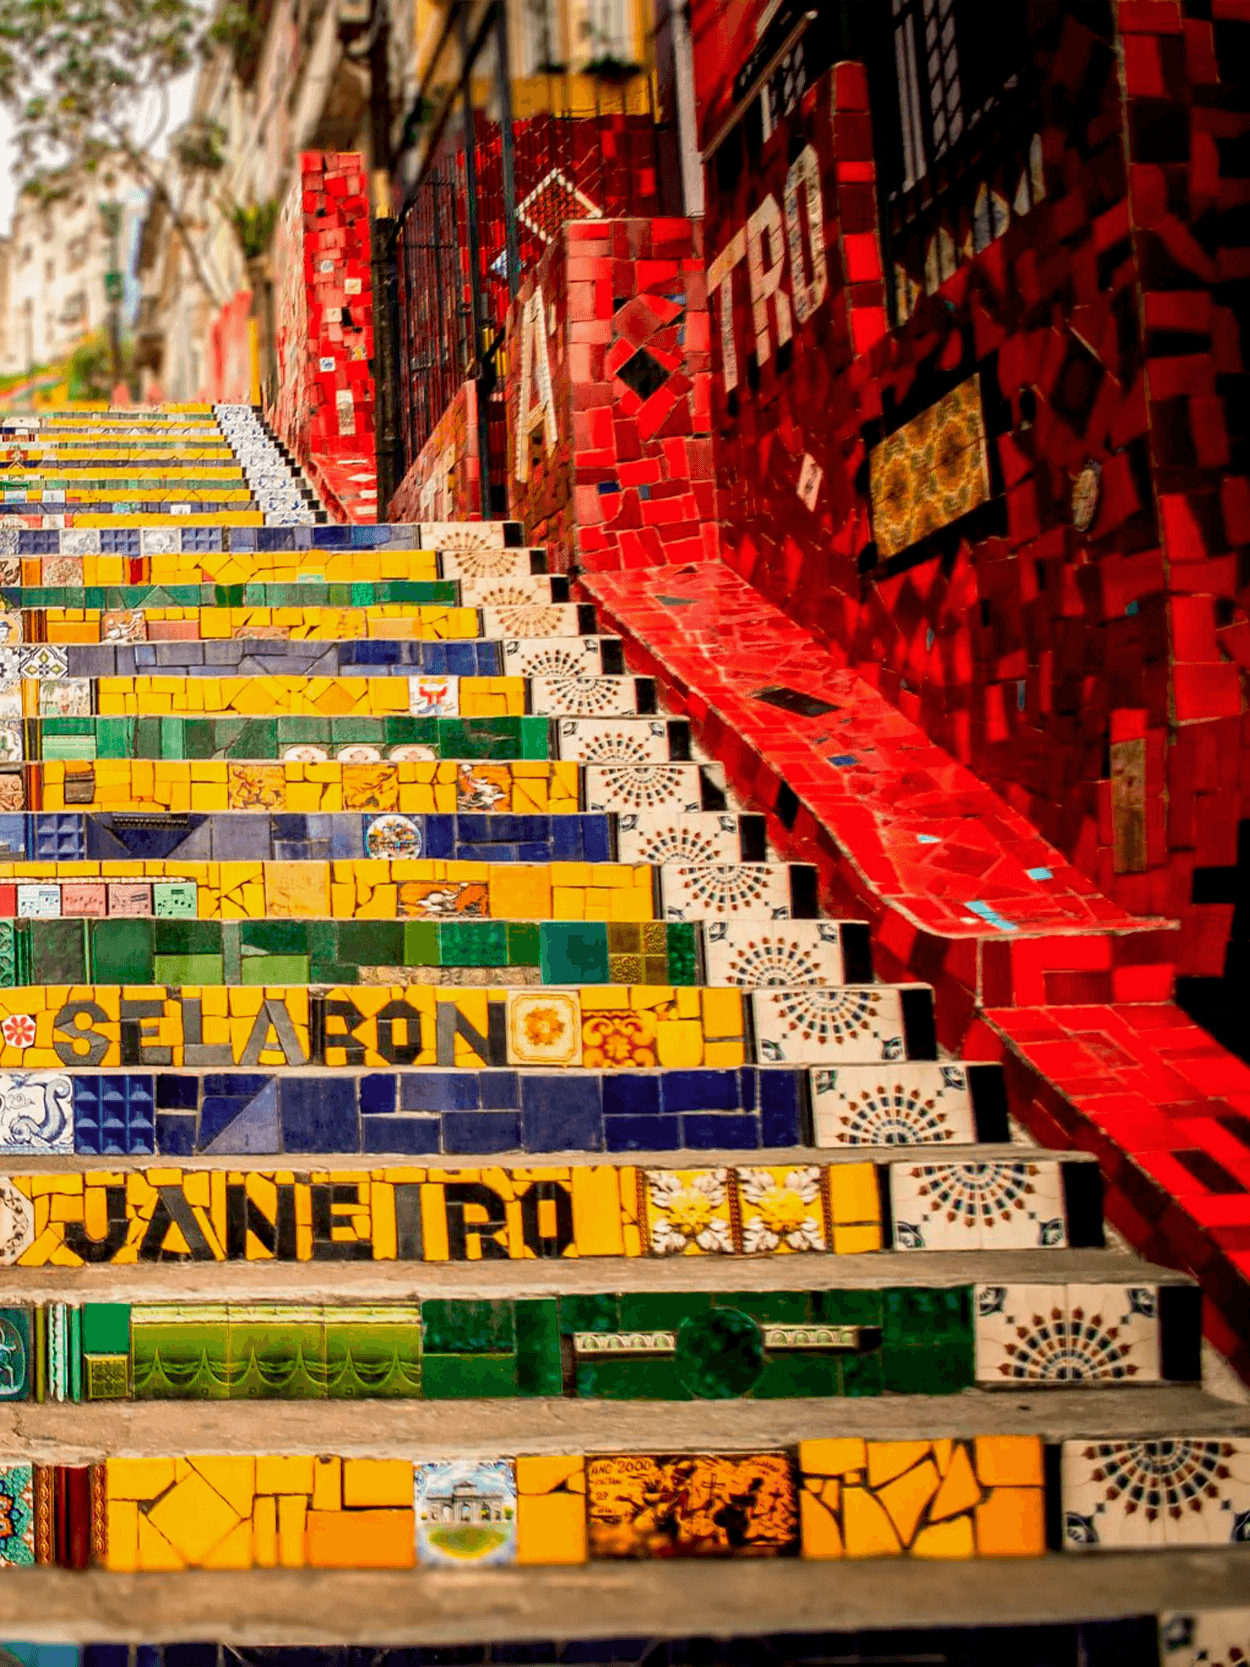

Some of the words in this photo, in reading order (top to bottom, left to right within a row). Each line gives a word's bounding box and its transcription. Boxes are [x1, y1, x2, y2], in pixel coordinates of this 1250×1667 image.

[707, 143, 828, 395] TRO
[53, 998, 507, 1067] SELARON
[61, 1180, 575, 1263] JANEIRO
